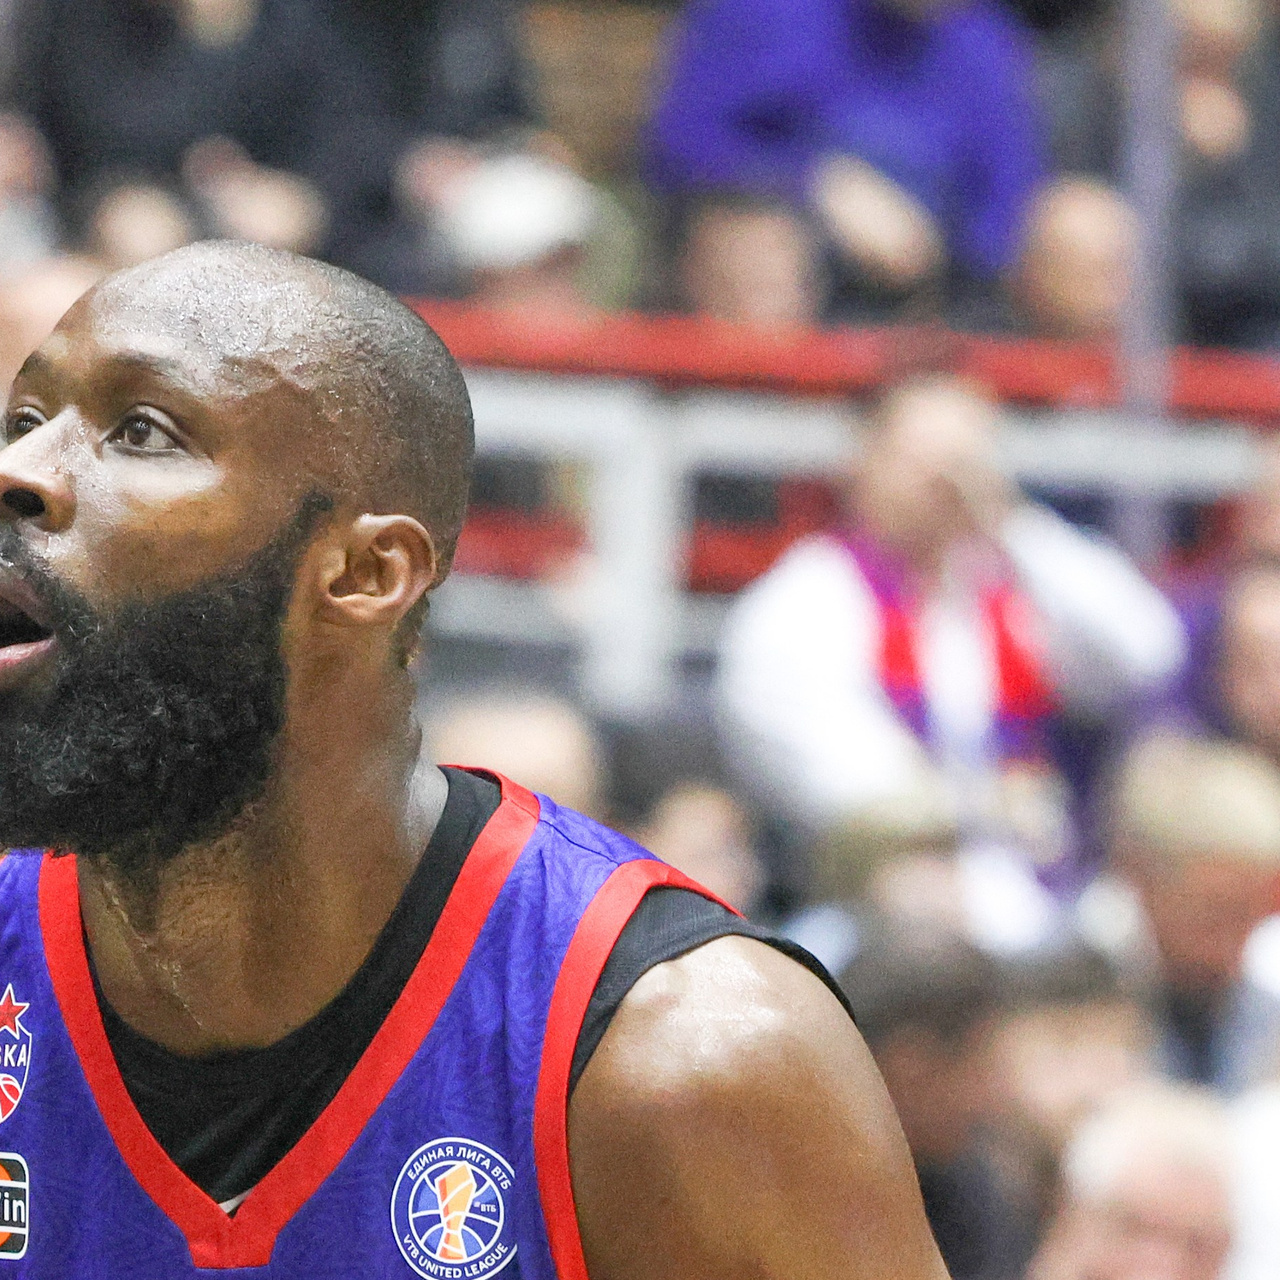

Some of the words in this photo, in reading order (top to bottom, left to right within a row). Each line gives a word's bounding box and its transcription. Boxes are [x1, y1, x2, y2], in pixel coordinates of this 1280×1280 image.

[407, 1145, 454, 1181] ЕДИНАЯ
[456, 1146, 492, 1170] ЛИГА
[490, 1165, 512, 1190] ВТБ
[403, 1234, 419, 1259] VTB
[418, 1256, 462, 1278] UNITED
[464, 1242, 508, 1277] LEAGUE
